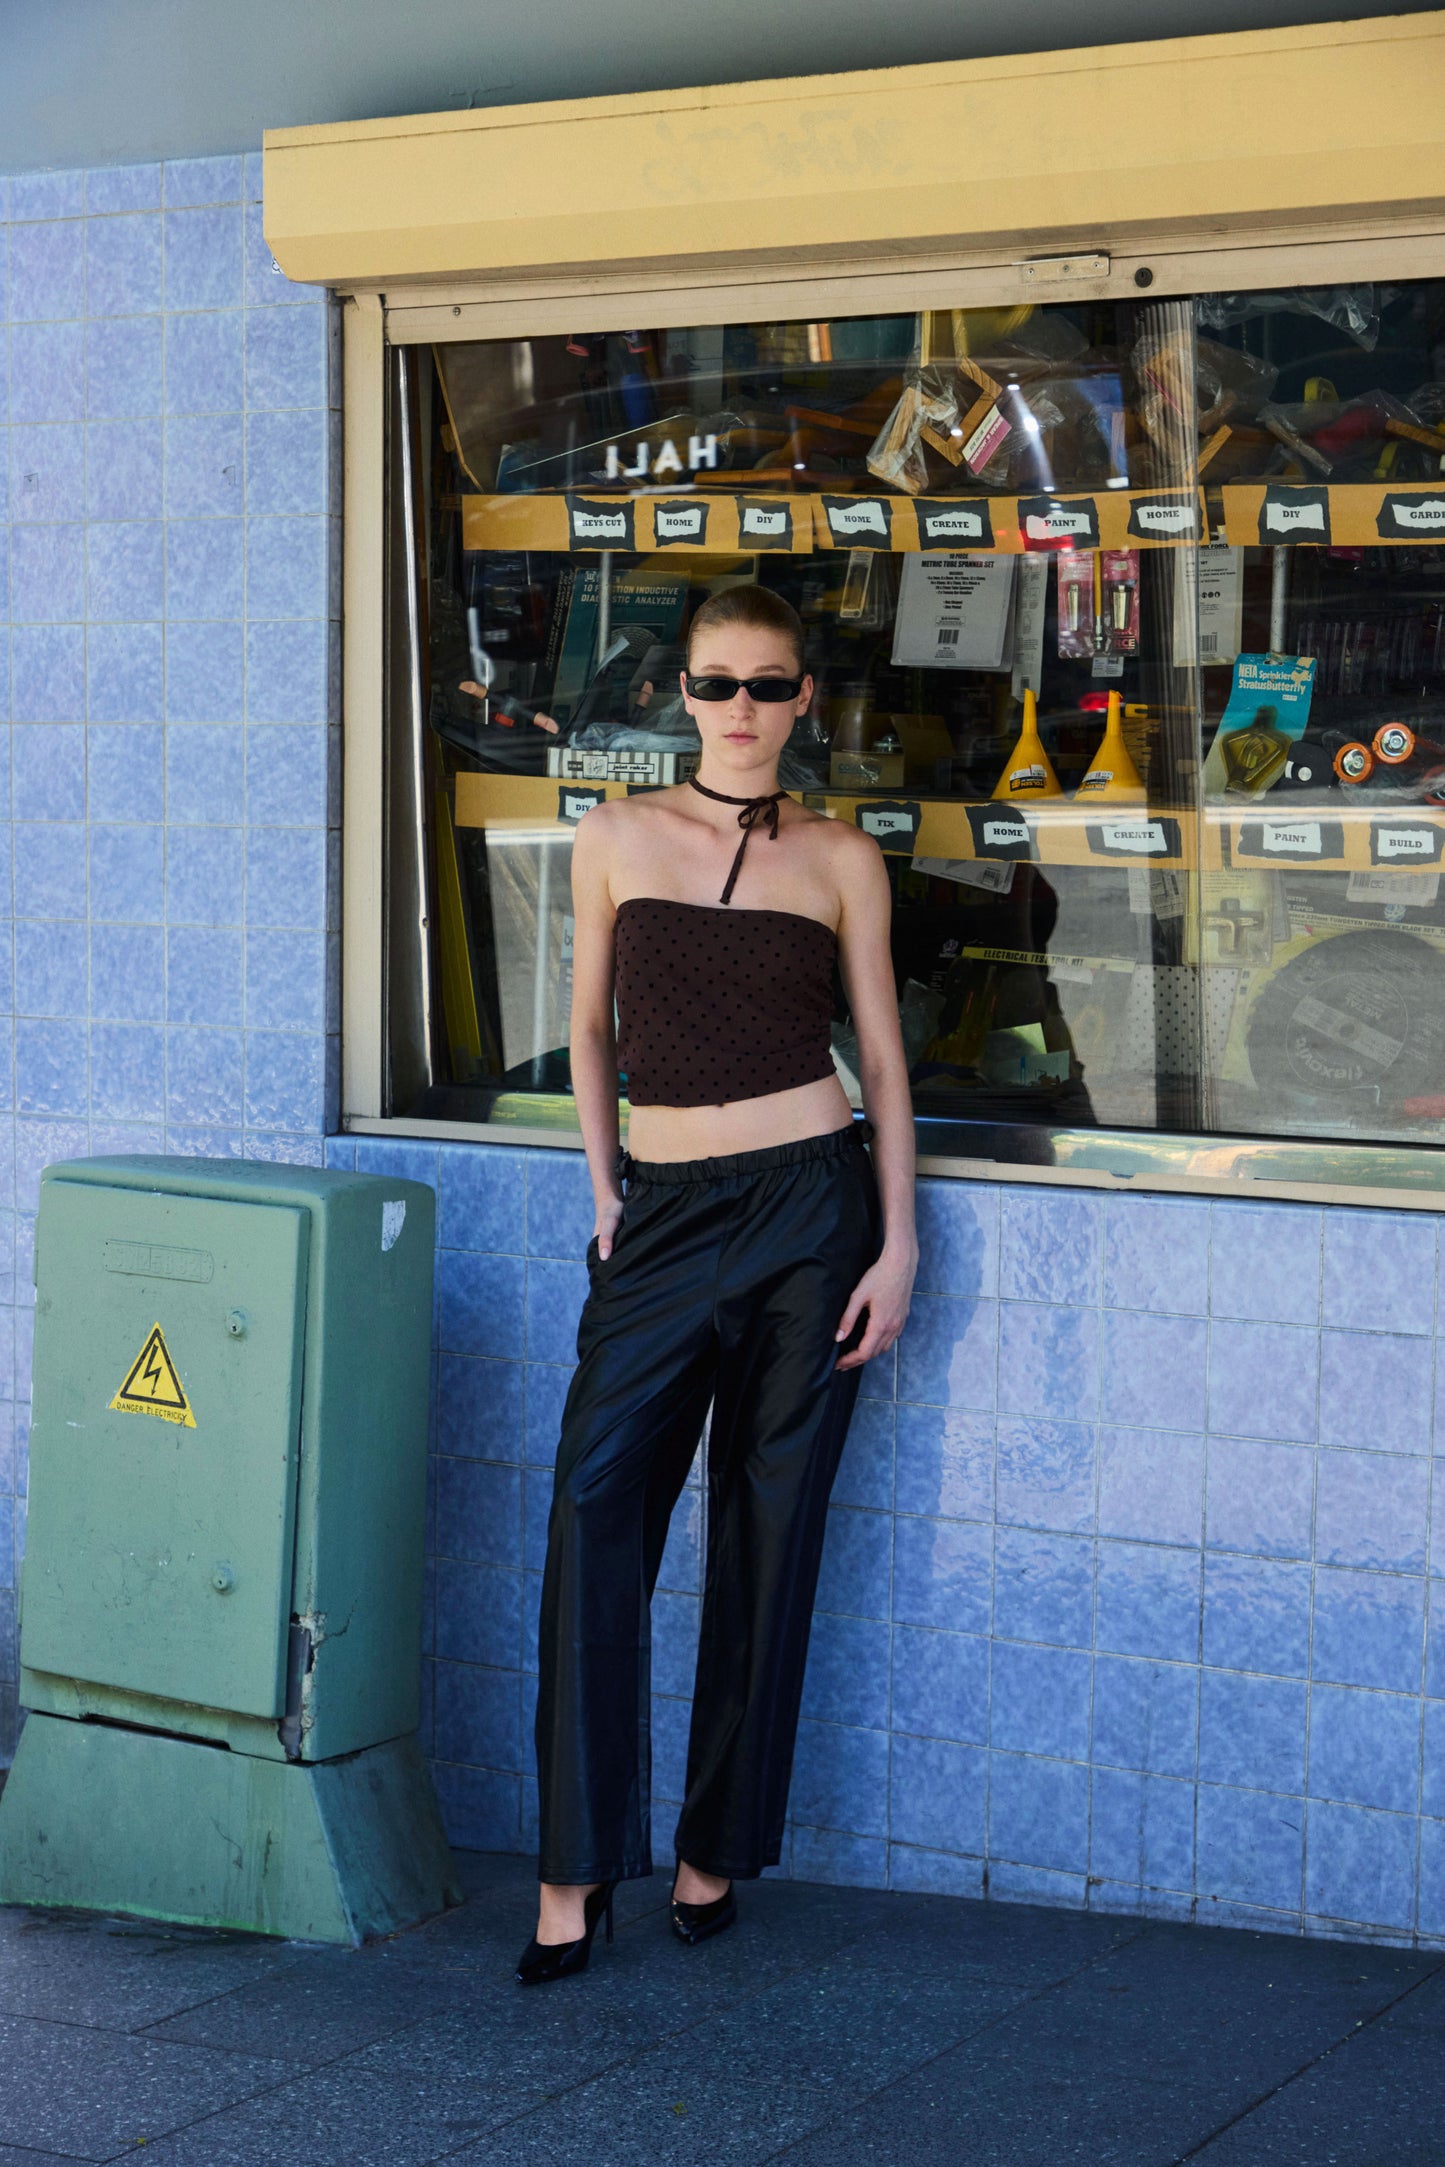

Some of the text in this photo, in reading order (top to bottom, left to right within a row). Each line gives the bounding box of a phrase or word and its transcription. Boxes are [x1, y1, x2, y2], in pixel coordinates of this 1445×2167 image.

[844, 514, 872, 524] HOME
[1146, 510, 1180, 520] HOME
[1282, 510, 1301, 519] DIY
[582, 518, 622, 528] KEYS CUT
[666, 518, 694, 527] HOME
[756, 516, 774, 525] DIY
[932, 520, 970, 529] CREATE
[1044, 519, 1077, 528] PAINT
[583, 584, 593, 592] 10
[635, 586, 680, 595] INDUCTIVE
[635, 596, 677, 605] ANALYZER
[576, 804, 591, 813] DIY
[877, 818, 896, 828] FIX
[993, 828, 1024, 838] HOME
[1114, 830, 1155, 840] CREATE
[1275, 834, 1307, 844] PAINT
[1389, 840, 1422, 849] BUILD
[983, 950, 1028, 962] ELECTRICAL
[1072, 958, 1085, 966] KIT
[116, 1402, 144, 1414] DANGER
